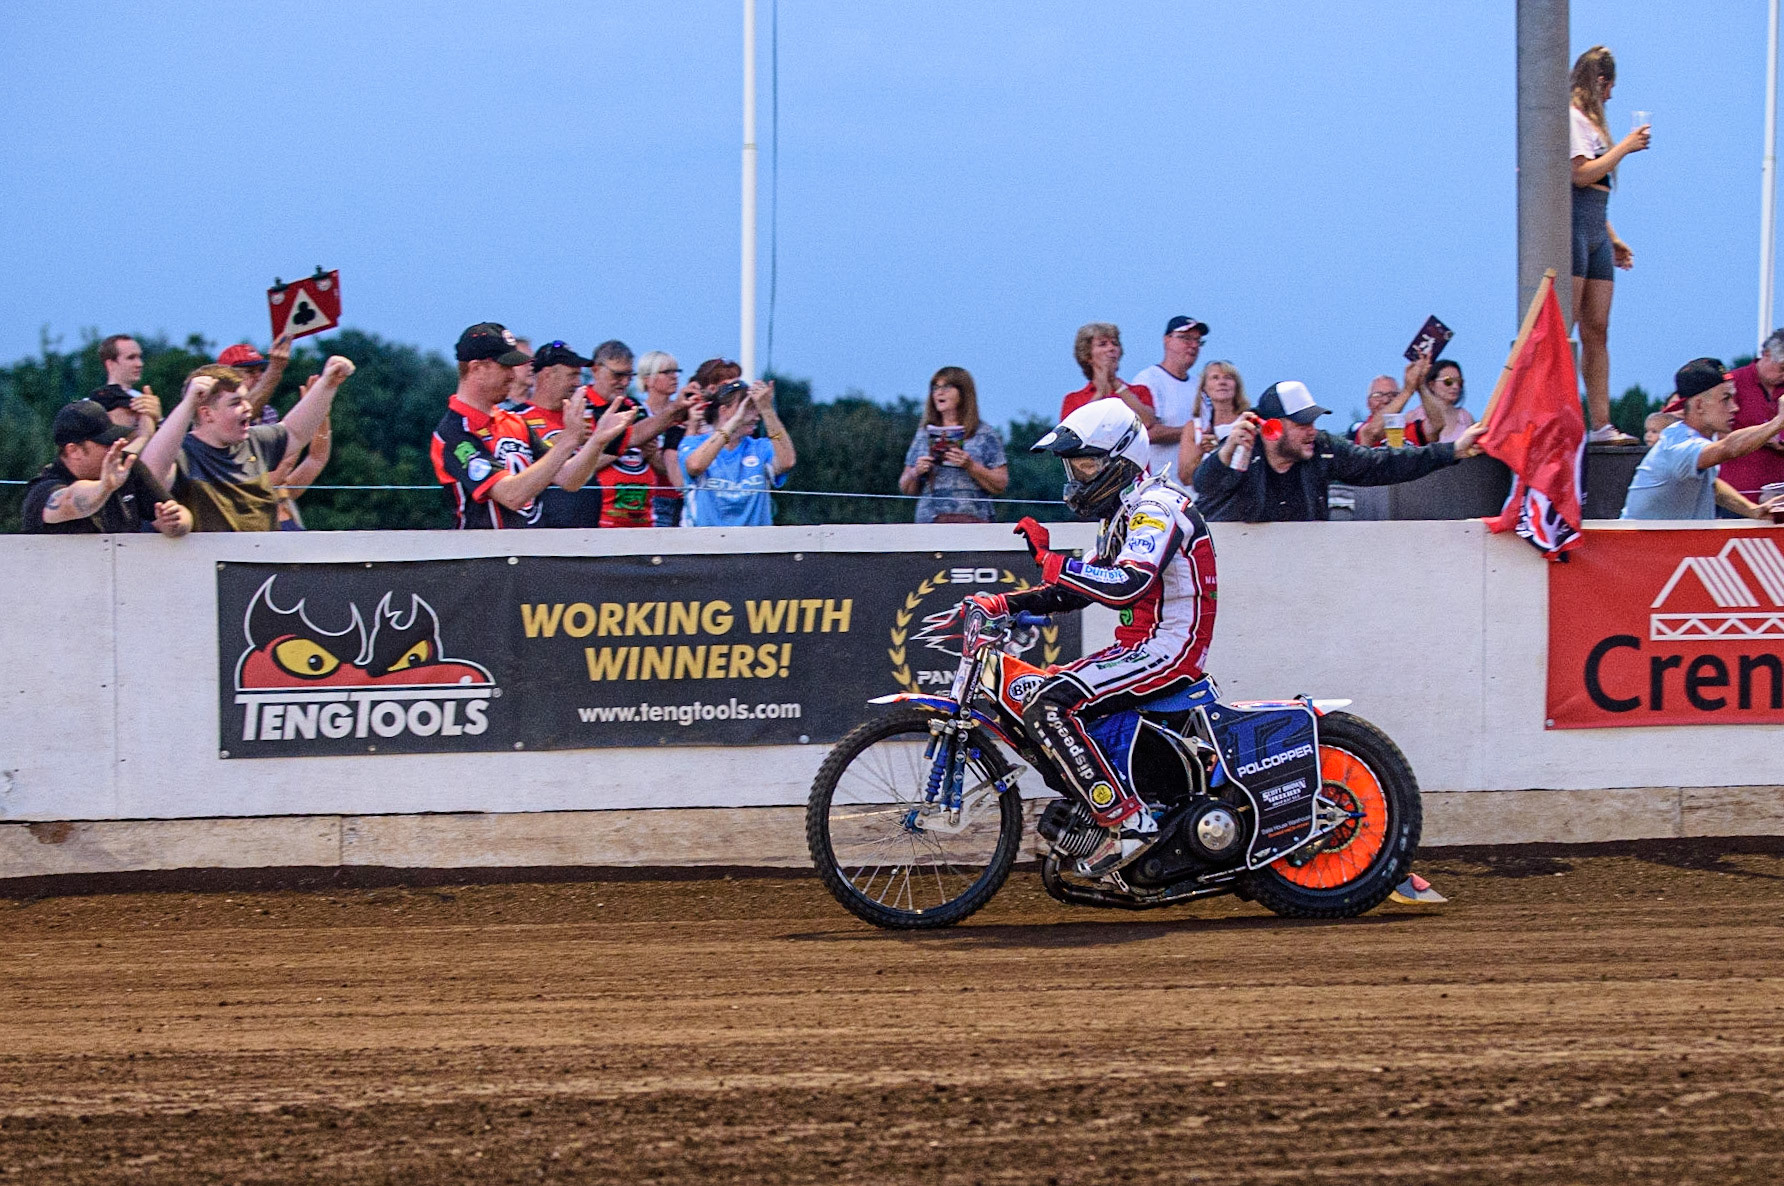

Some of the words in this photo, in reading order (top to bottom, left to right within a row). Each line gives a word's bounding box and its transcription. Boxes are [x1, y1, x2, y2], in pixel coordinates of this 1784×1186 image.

[950, 567, 999, 584] 50
[520, 600, 735, 638] WORKING
[745, 598, 853, 634] WITH
[584, 643, 793, 681] WINNERS!
[577, 698, 802, 726] www.tengtools.com
[1236, 744, 1314, 777] POLCOPPER
